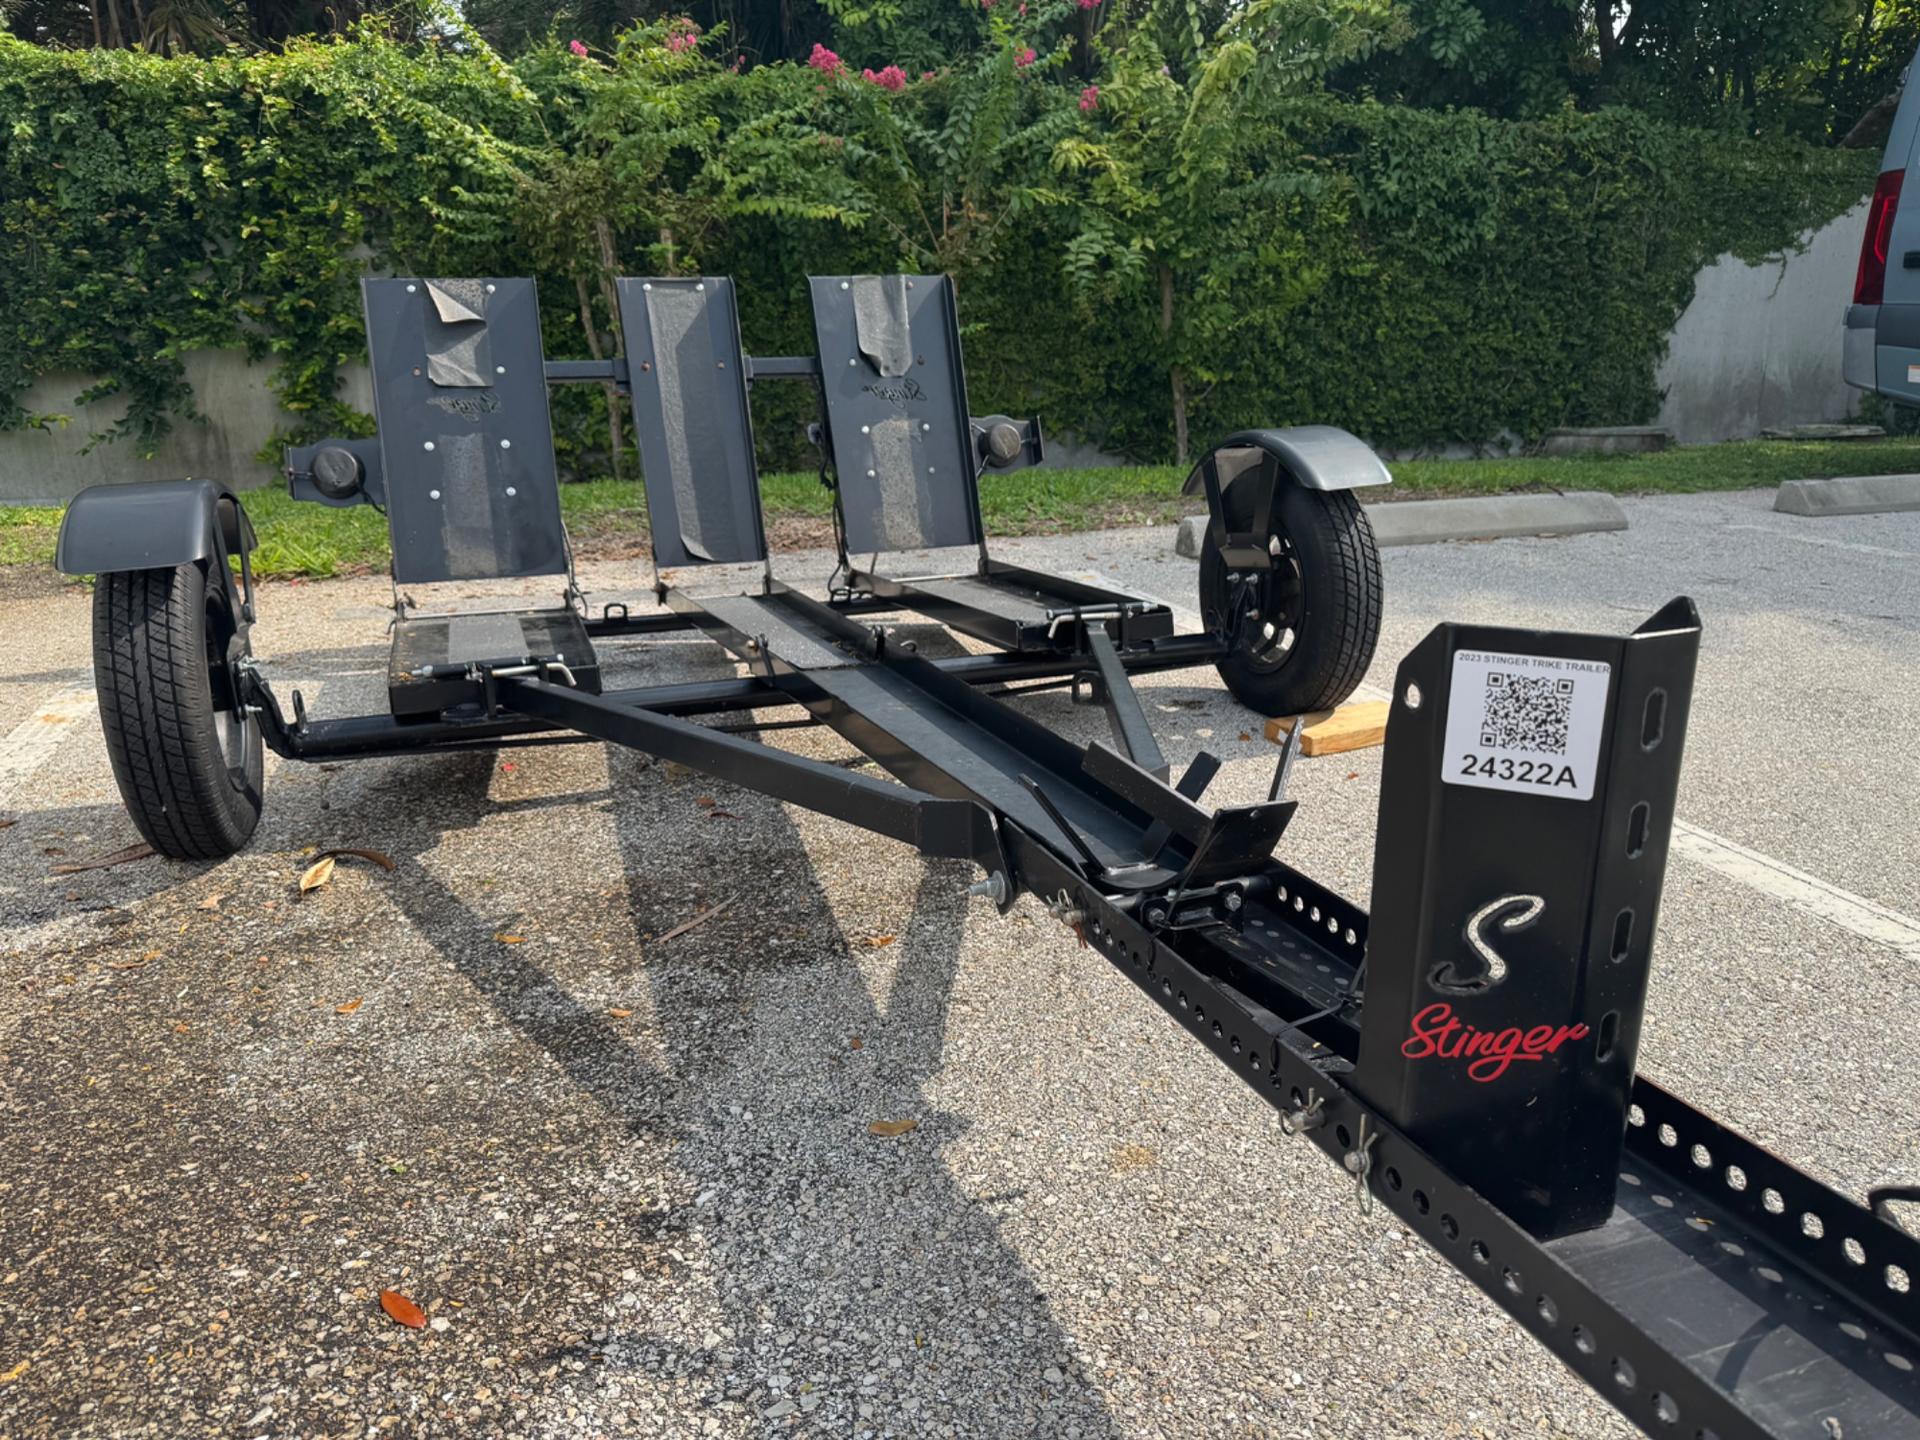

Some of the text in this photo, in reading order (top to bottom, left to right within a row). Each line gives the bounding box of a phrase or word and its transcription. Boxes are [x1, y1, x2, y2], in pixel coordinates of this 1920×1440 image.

[1459, 652, 1611, 674] 2023 STINGER TRIKE TRAILER
[1460, 754, 1577, 789] 24322A
[1401, 1003, 1590, 1082] Stinger
